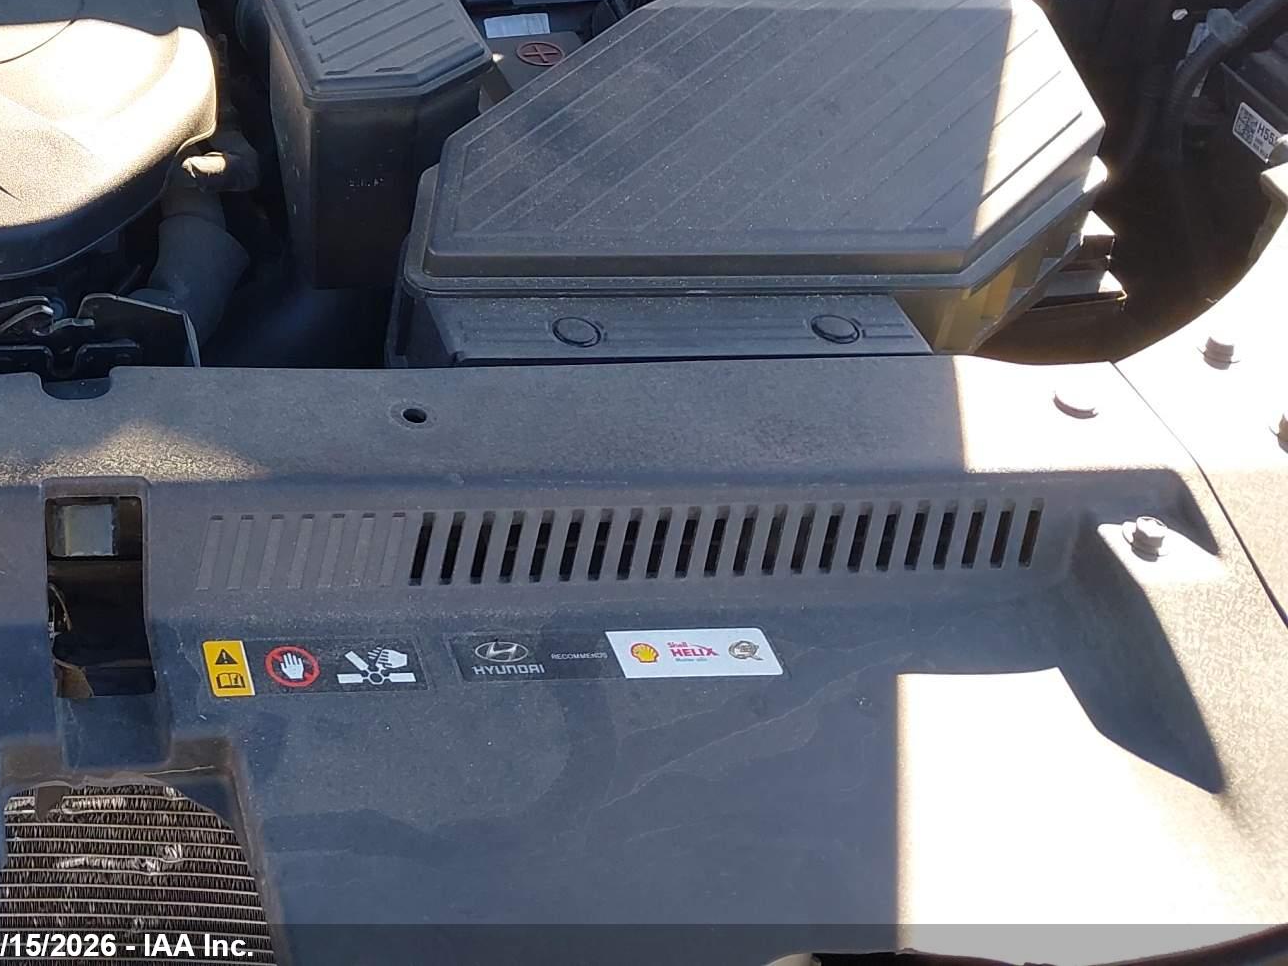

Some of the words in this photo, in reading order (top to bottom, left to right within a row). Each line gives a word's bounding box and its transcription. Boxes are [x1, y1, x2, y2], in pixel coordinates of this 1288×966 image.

[551, 651, 608, 660] RECOMMENDS
[670, 647, 719, 657] HELIX
[472, 663, 545, 675] HYUNDAI
